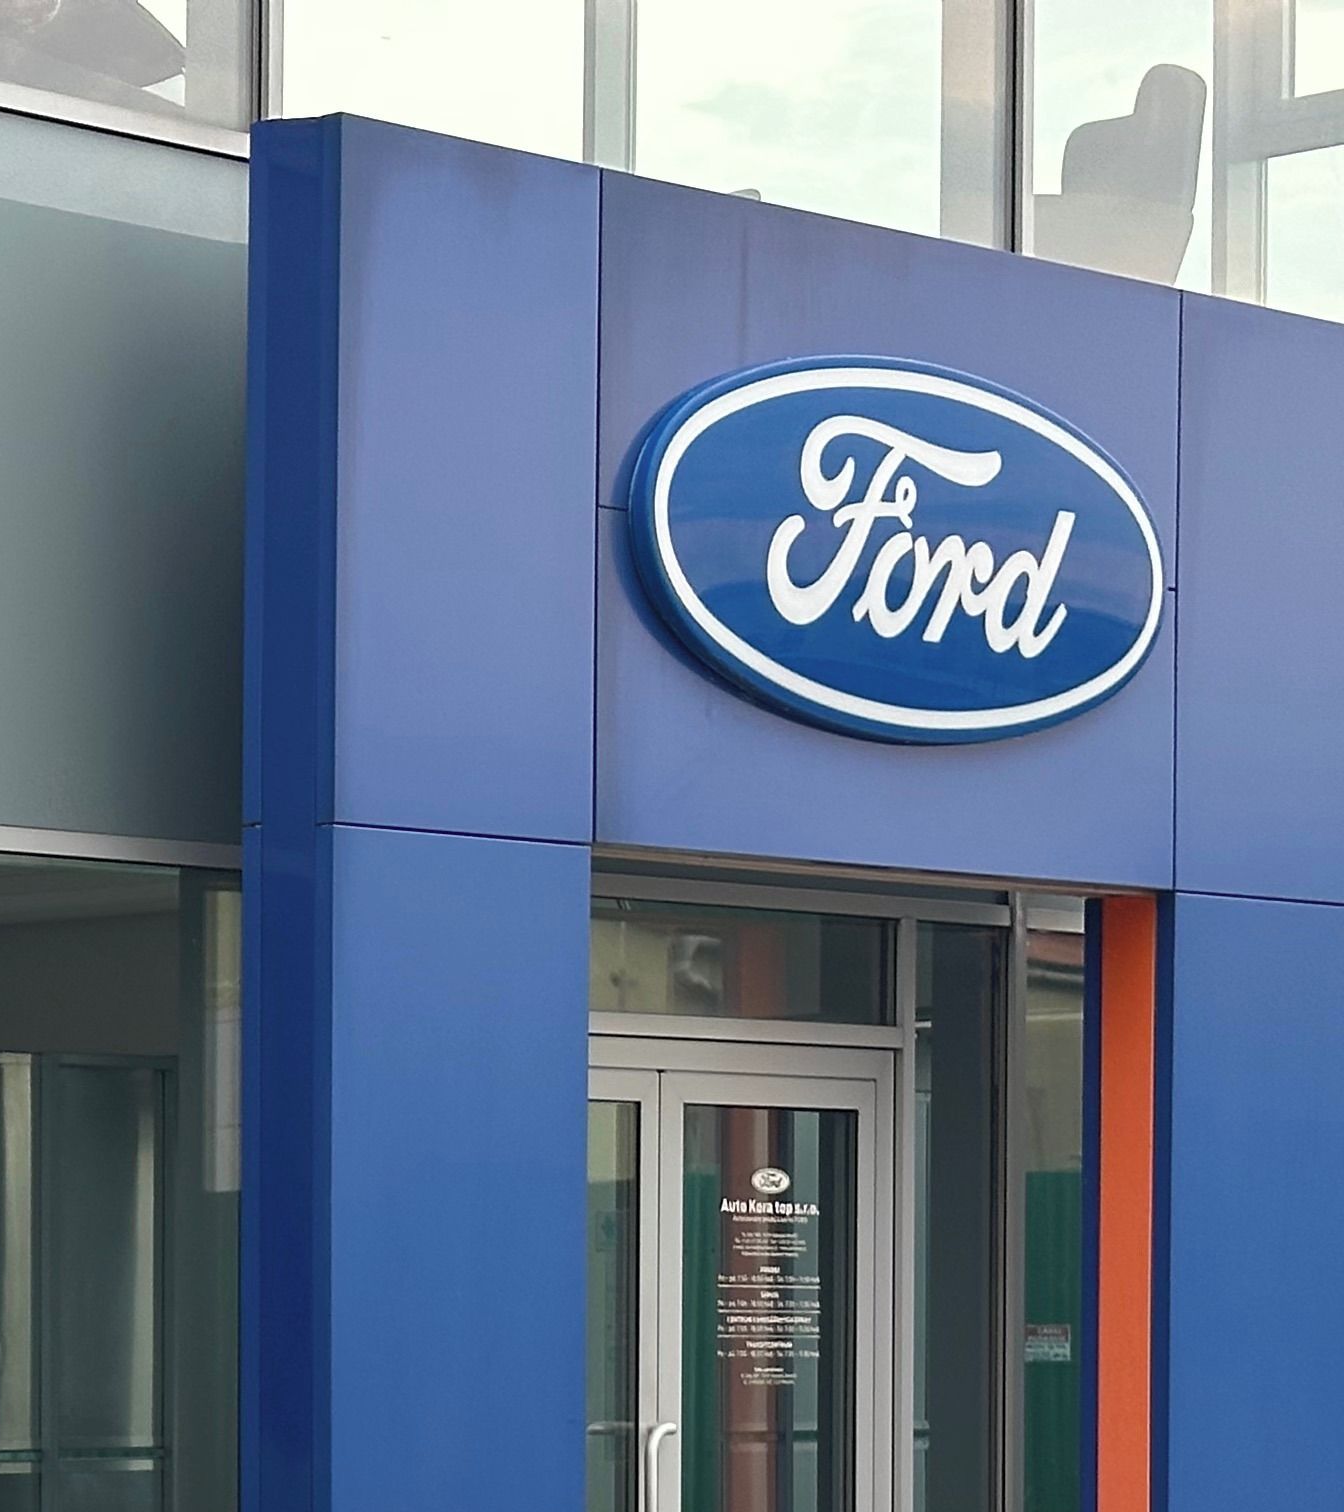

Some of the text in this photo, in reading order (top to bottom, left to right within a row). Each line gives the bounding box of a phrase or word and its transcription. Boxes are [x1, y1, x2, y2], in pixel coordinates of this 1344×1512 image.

[766, 414, 1076, 659] Ford
[720, 1198, 747, 1213] Auto
[749, 1199, 773, 1214] Kora
[774, 1201, 792, 1216] top
